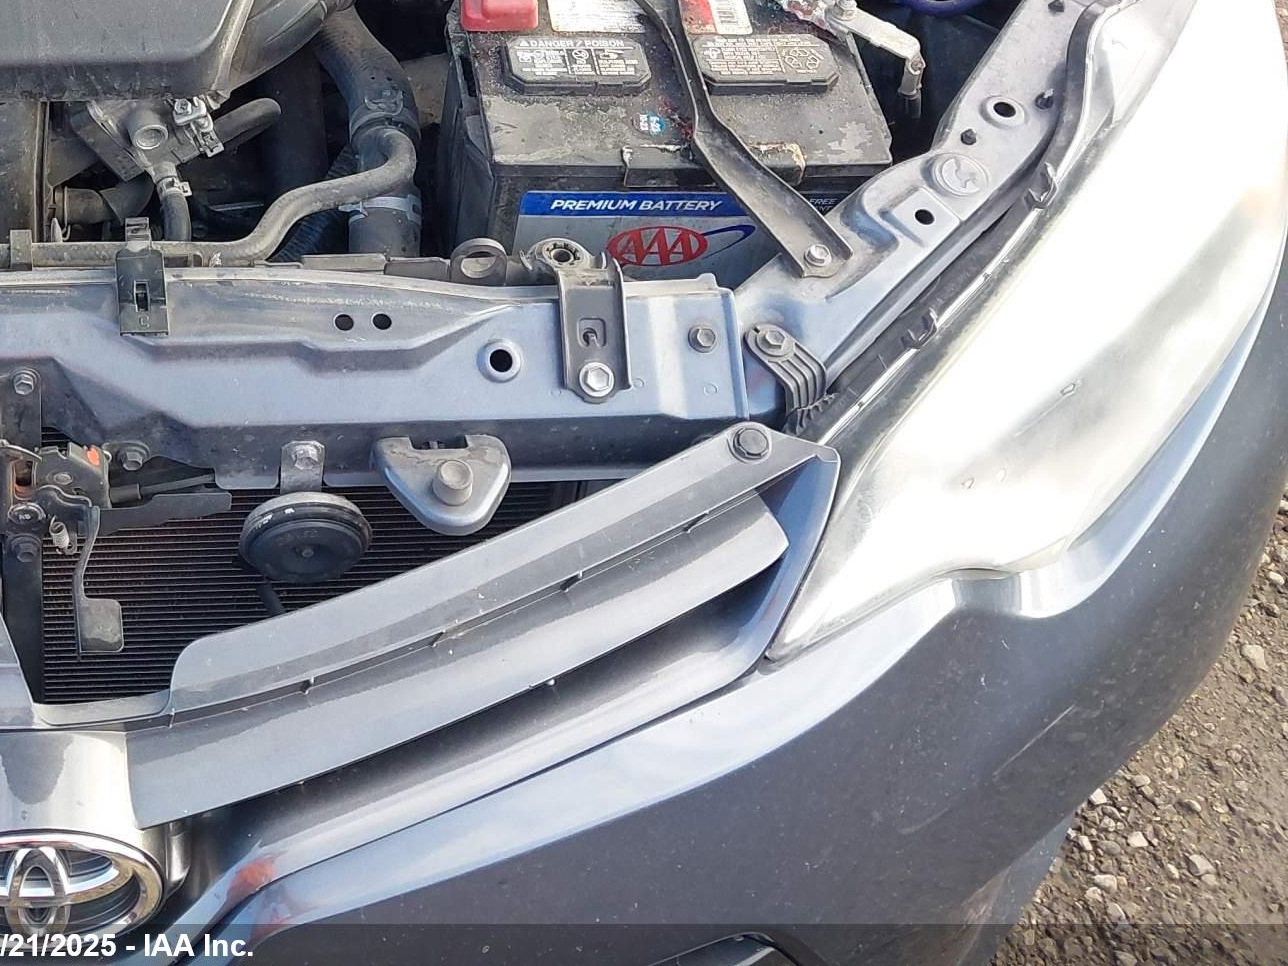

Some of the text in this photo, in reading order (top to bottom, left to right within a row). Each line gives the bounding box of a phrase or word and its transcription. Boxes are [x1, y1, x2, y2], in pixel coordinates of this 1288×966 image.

[529, 39, 575, 48] DANGER
[584, 39, 625, 47] POISON
[550, 198, 724, 211] PREMIUM BATTERY
[610, 225, 705, 267] AAA
